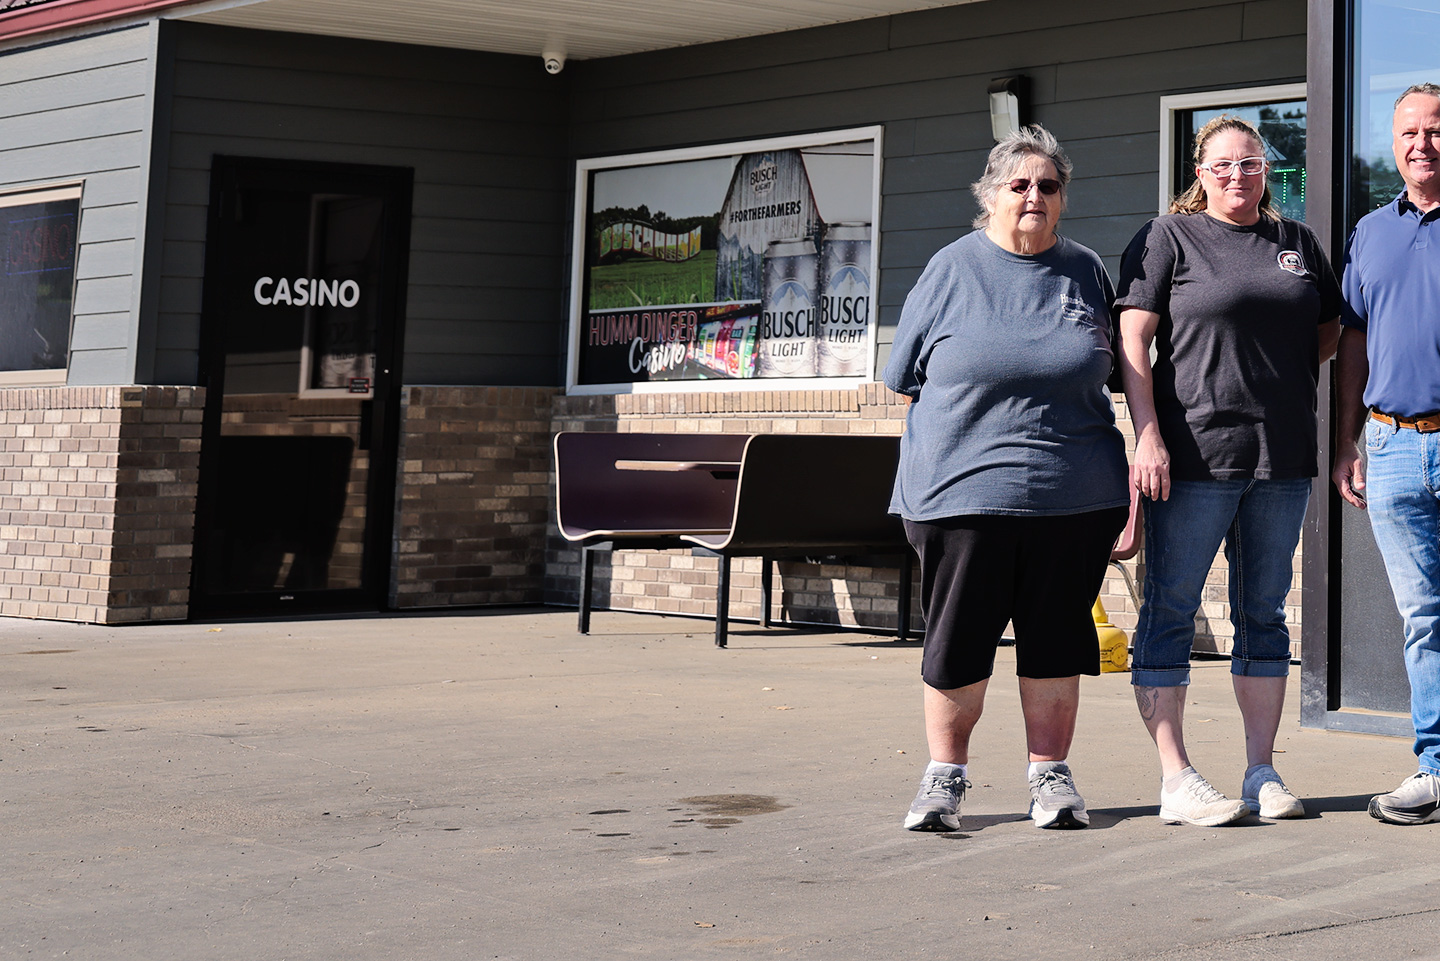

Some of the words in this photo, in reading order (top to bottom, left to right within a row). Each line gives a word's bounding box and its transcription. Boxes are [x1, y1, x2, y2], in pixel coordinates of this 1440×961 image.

[750, 166, 777, 185] BUSCH
[754, 182, 771, 191] LIGHT
[730, 200, 802, 223] #FORTHEFARMERS
[10, 224, 71, 266] CASINO
[254, 276, 360, 308] CASINO
[589, 314, 638, 346] HUMM
[641, 311, 698, 343] DINGER
[763, 308, 815, 339] BUSCH
[828, 329, 864, 343] LIGHT
[628, 336, 686, 374] Casino
[772, 342, 806, 357] LIGHT
